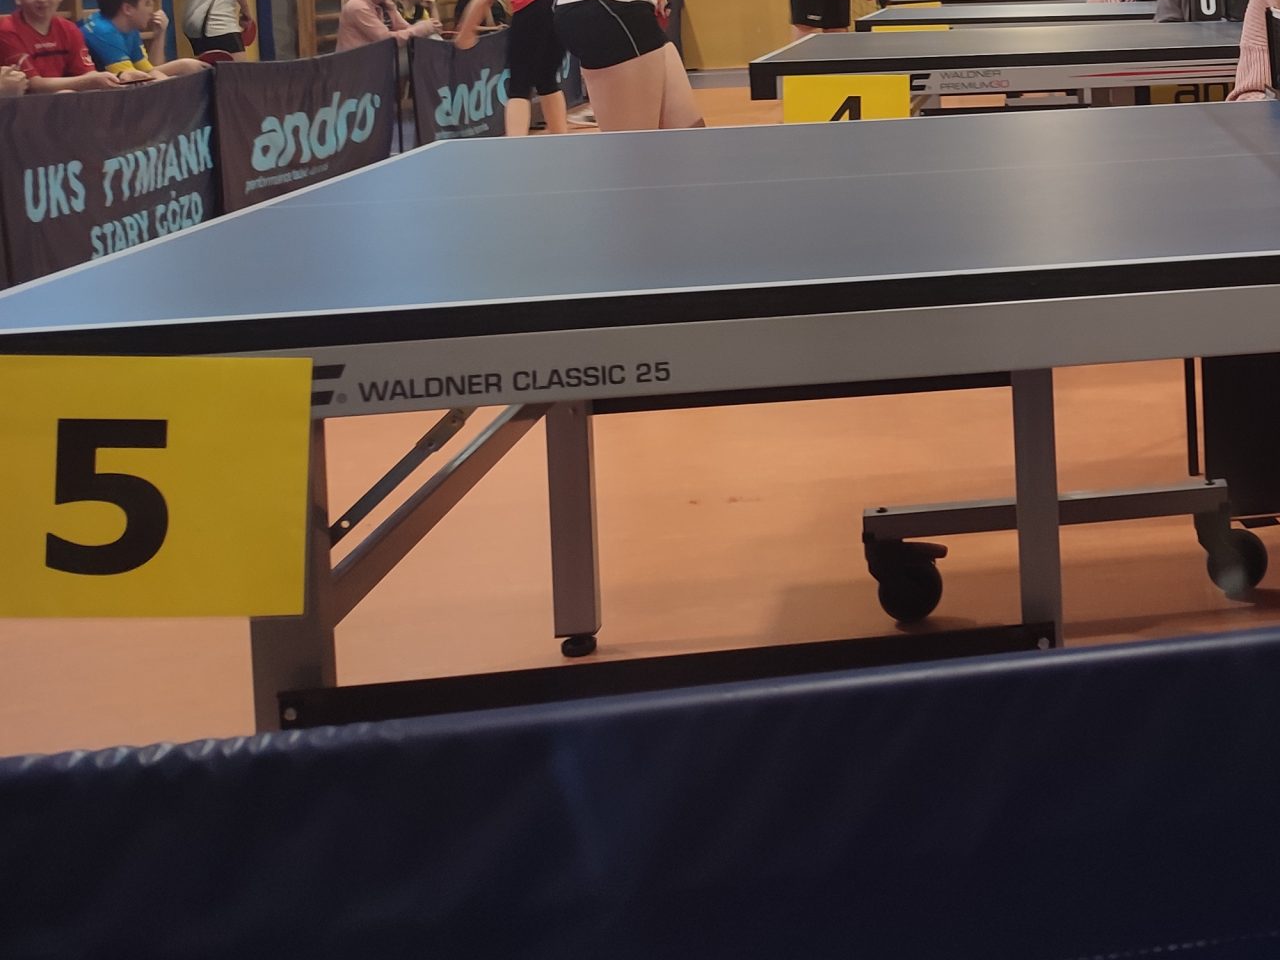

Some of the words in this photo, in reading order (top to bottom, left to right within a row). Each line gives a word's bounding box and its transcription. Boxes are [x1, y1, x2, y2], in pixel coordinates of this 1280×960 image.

[940, 69, 1001, 80] WALDNER
[251, 91, 373, 172] andro
[24, 160, 86, 223] UKS
[90, 209, 149, 260] STARY
[358, 372, 502, 403] WALDNER
[512, 365, 626, 391] CLASSIC
[636, 361, 671, 383] 25
[45, 418, 169, 576] 5
